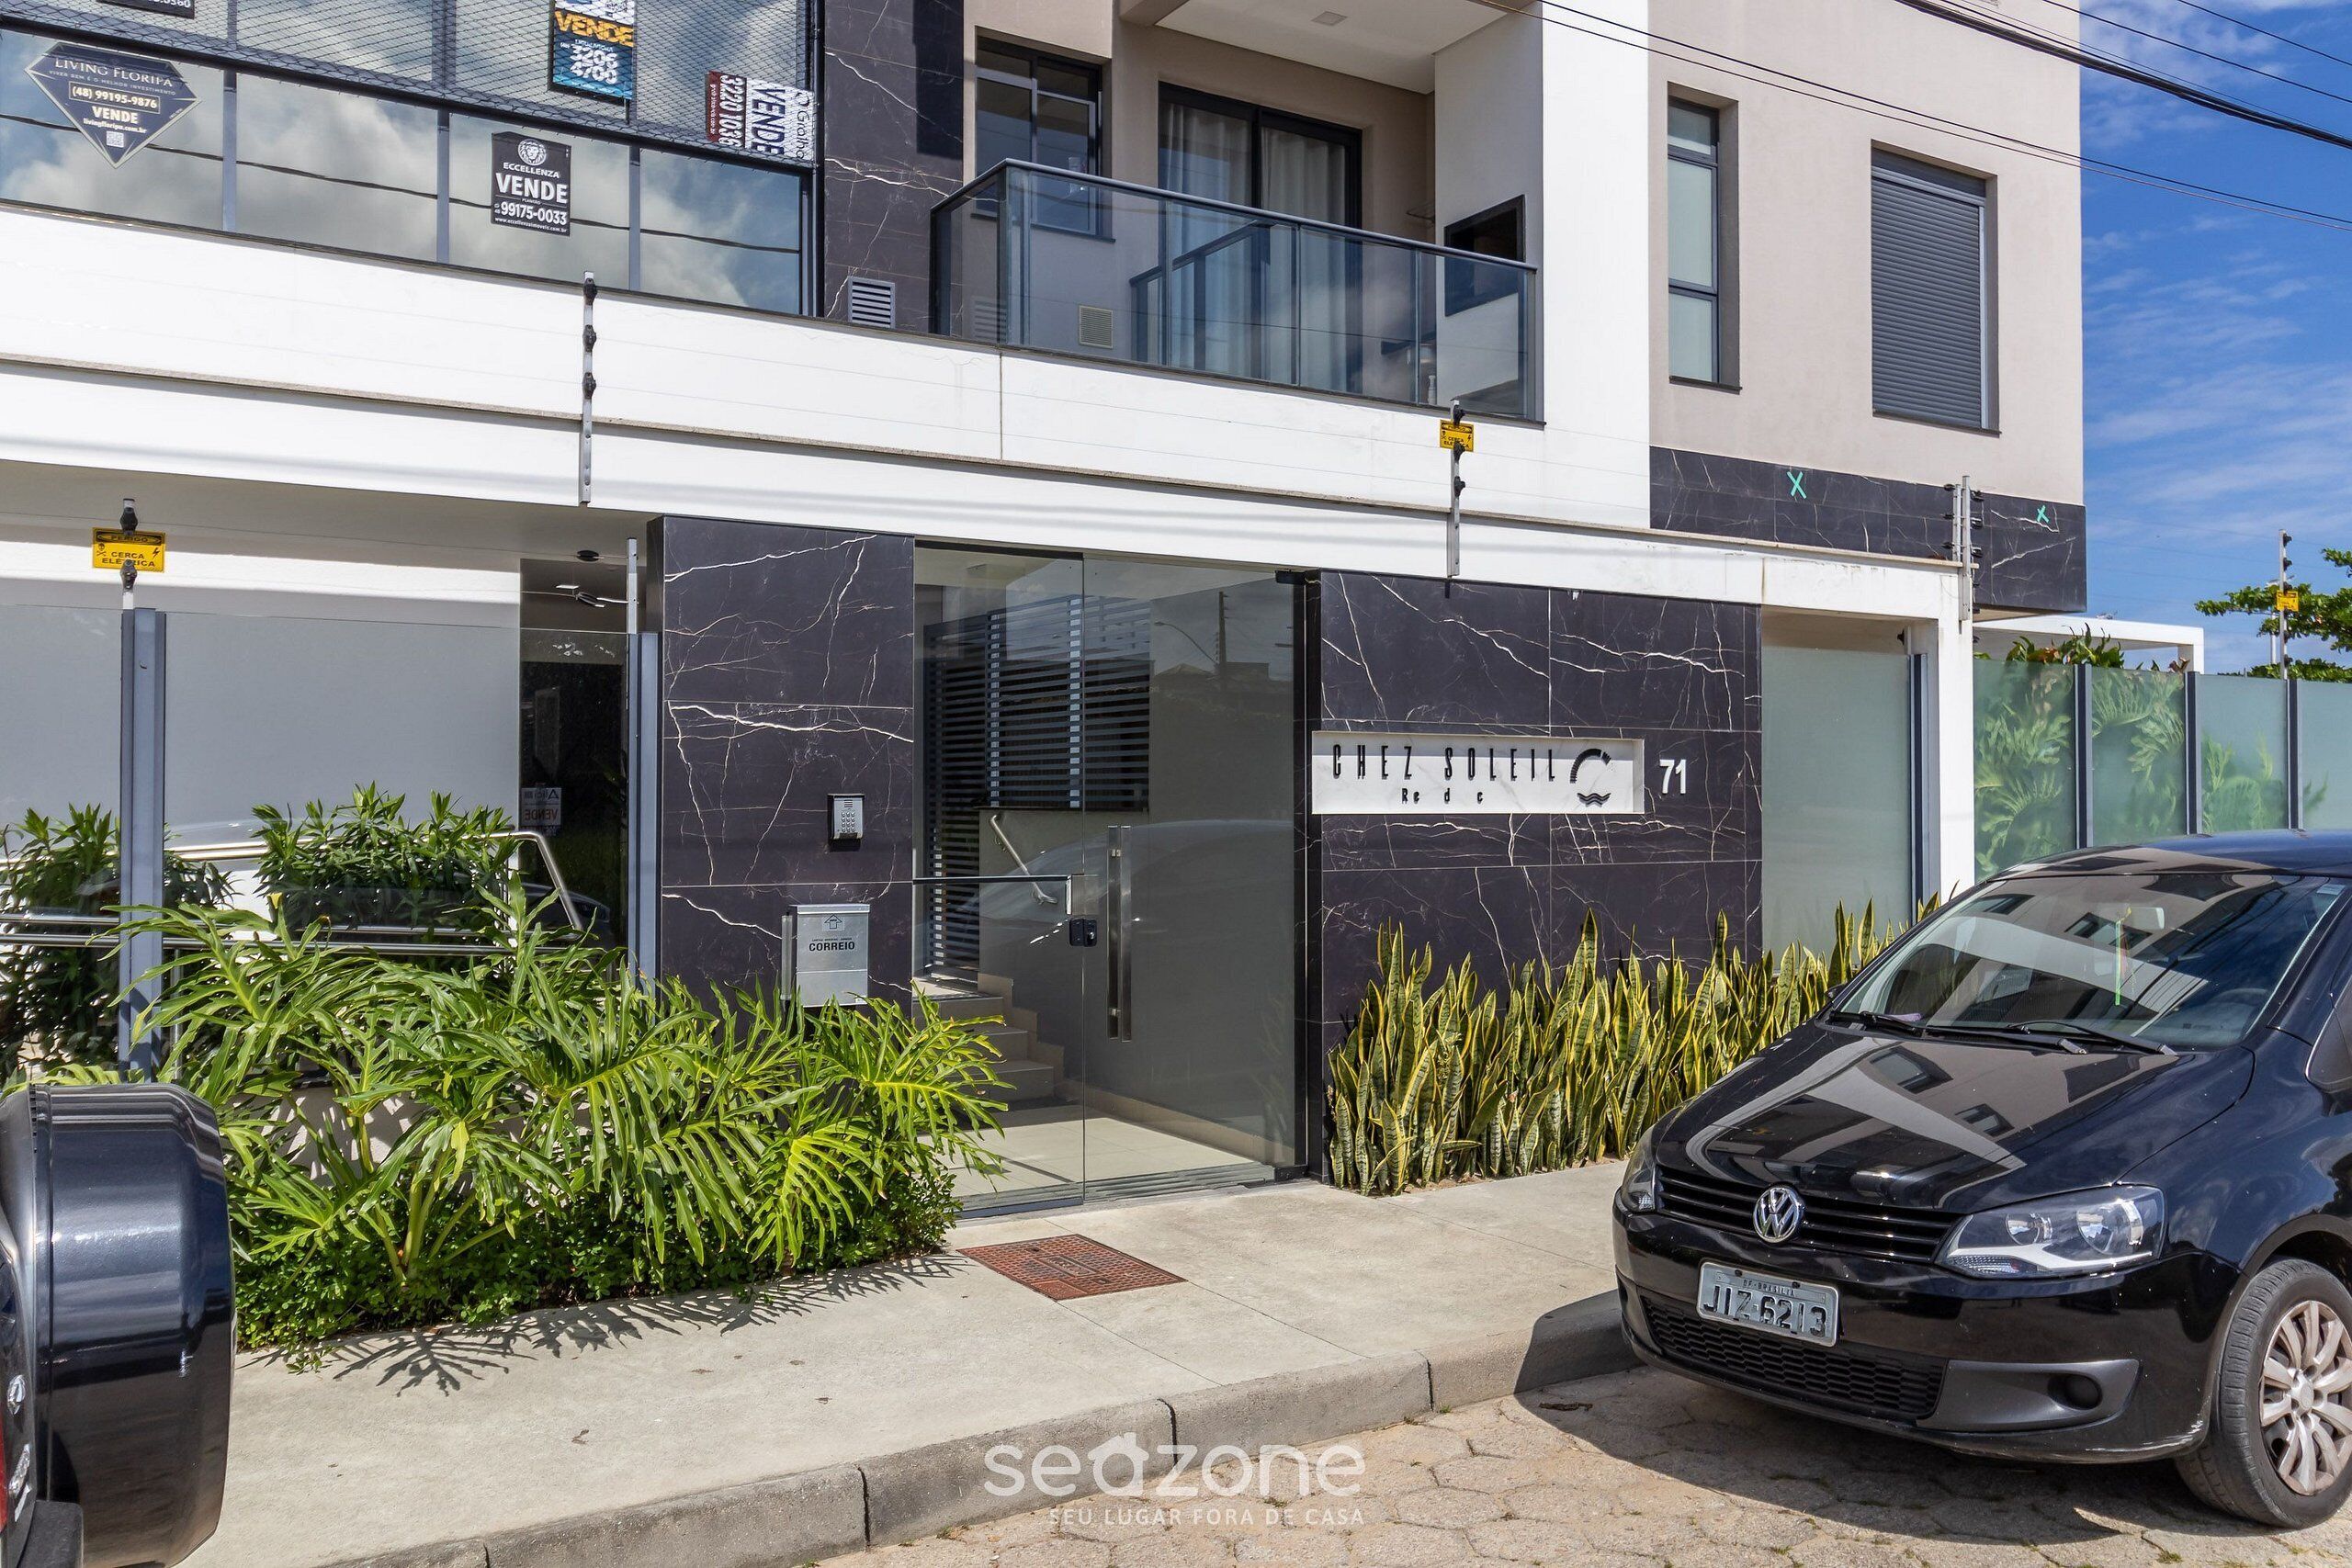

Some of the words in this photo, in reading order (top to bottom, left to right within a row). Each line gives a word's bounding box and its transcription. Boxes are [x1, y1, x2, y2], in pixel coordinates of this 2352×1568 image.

[554, 11, 633, 48] VENDE
[55, 58, 108, 76] LIVING
[114, 67, 173, 87] FLORIPA
[72, 85, 93, 99] (48)
[95, 90, 157, 108] 99195-9876
[101, 79, 128, 87] MELHOR
[130, 84, 176, 96] INVESTIMENTO
[719, 74, 745, 112] 3220
[92, 106, 139, 125] VENDE
[752, 88, 786, 155] VENDE
[718, 113, 743, 148] 1036
[503, 162, 560, 179] ECCELLENZA
[495, 173, 568, 204] VENDE
[501, 201, 568, 226] 99175-0033
[111, 551, 145, 559] CERCA
[1332, 744, 1413, 780] CHEZ
[1444, 747, 1555, 781] SOLEIL
[1659, 759, 1687, 795] 71
[808, 941, 855, 952] CORREIO
